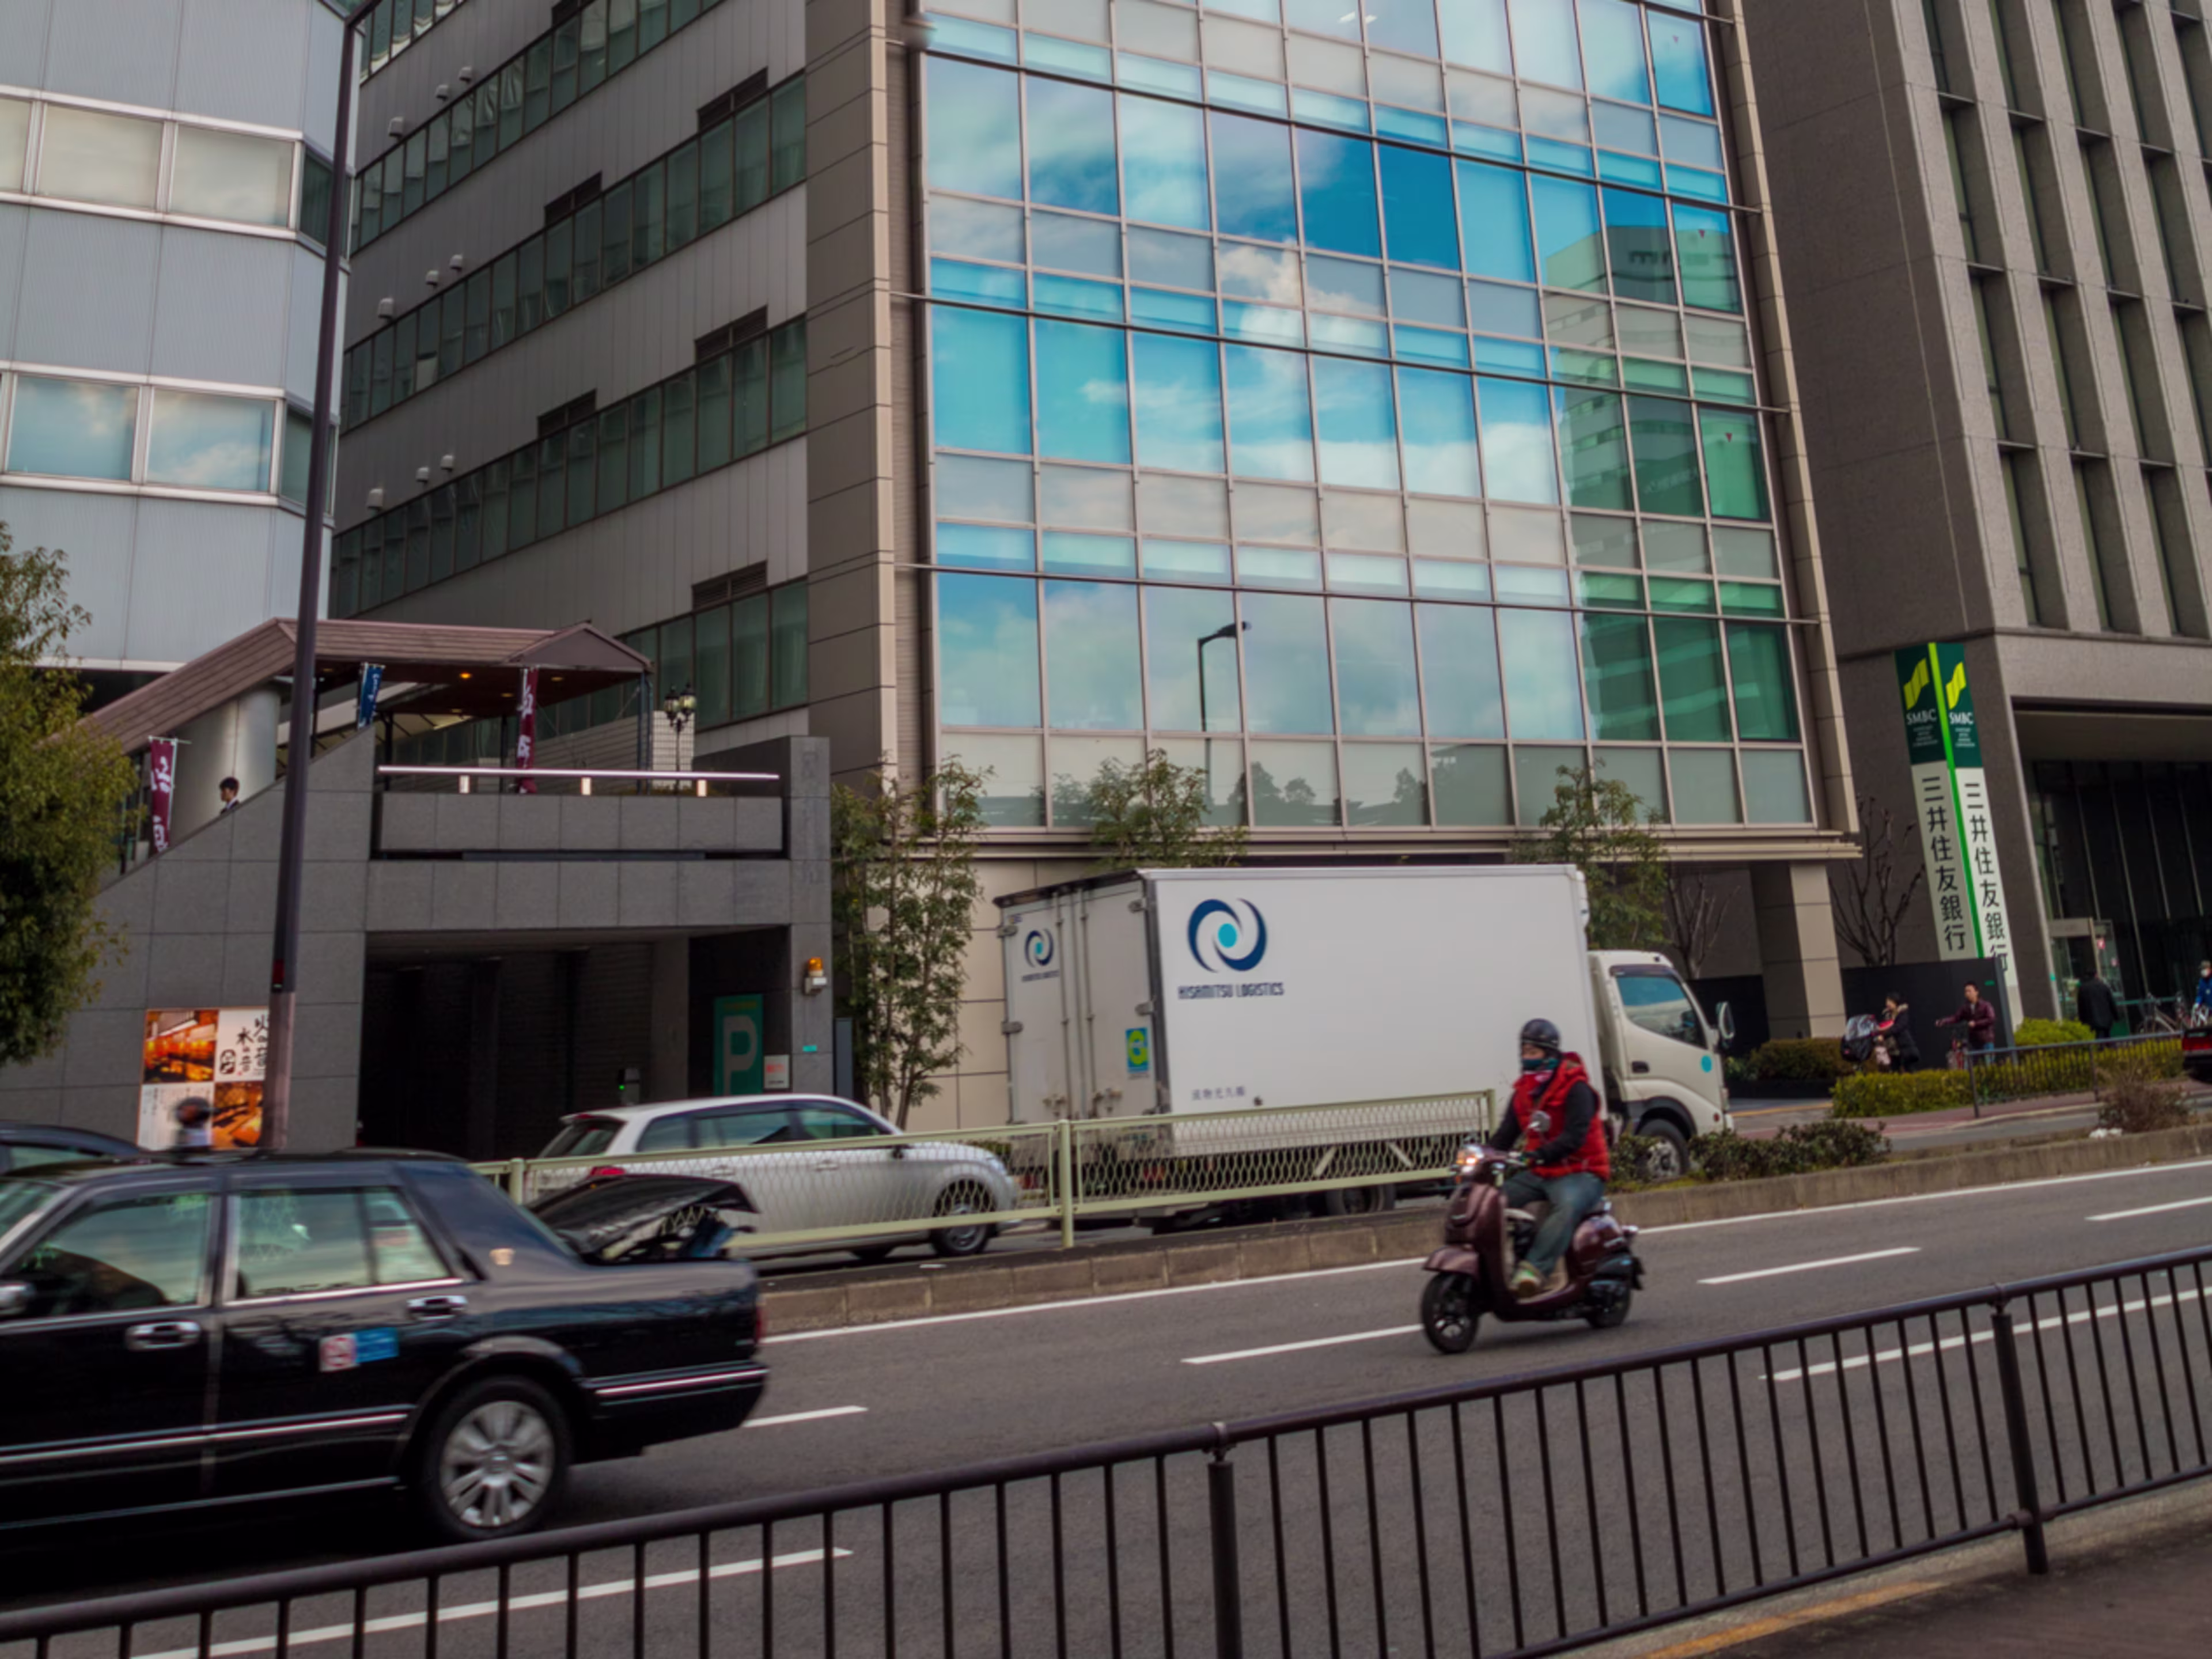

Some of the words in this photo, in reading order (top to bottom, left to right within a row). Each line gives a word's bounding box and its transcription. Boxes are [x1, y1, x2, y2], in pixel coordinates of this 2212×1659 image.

[1907, 709, 1937, 725] SMBC
[1949, 712, 1974, 725] SMBC
[1922, 776, 1966, 951] 三井住友銀行
[1178, 984, 1233, 999] HISAMITSU
[1237, 982, 1284, 997] LOGISTICS
[723, 1016, 757, 1095] P
